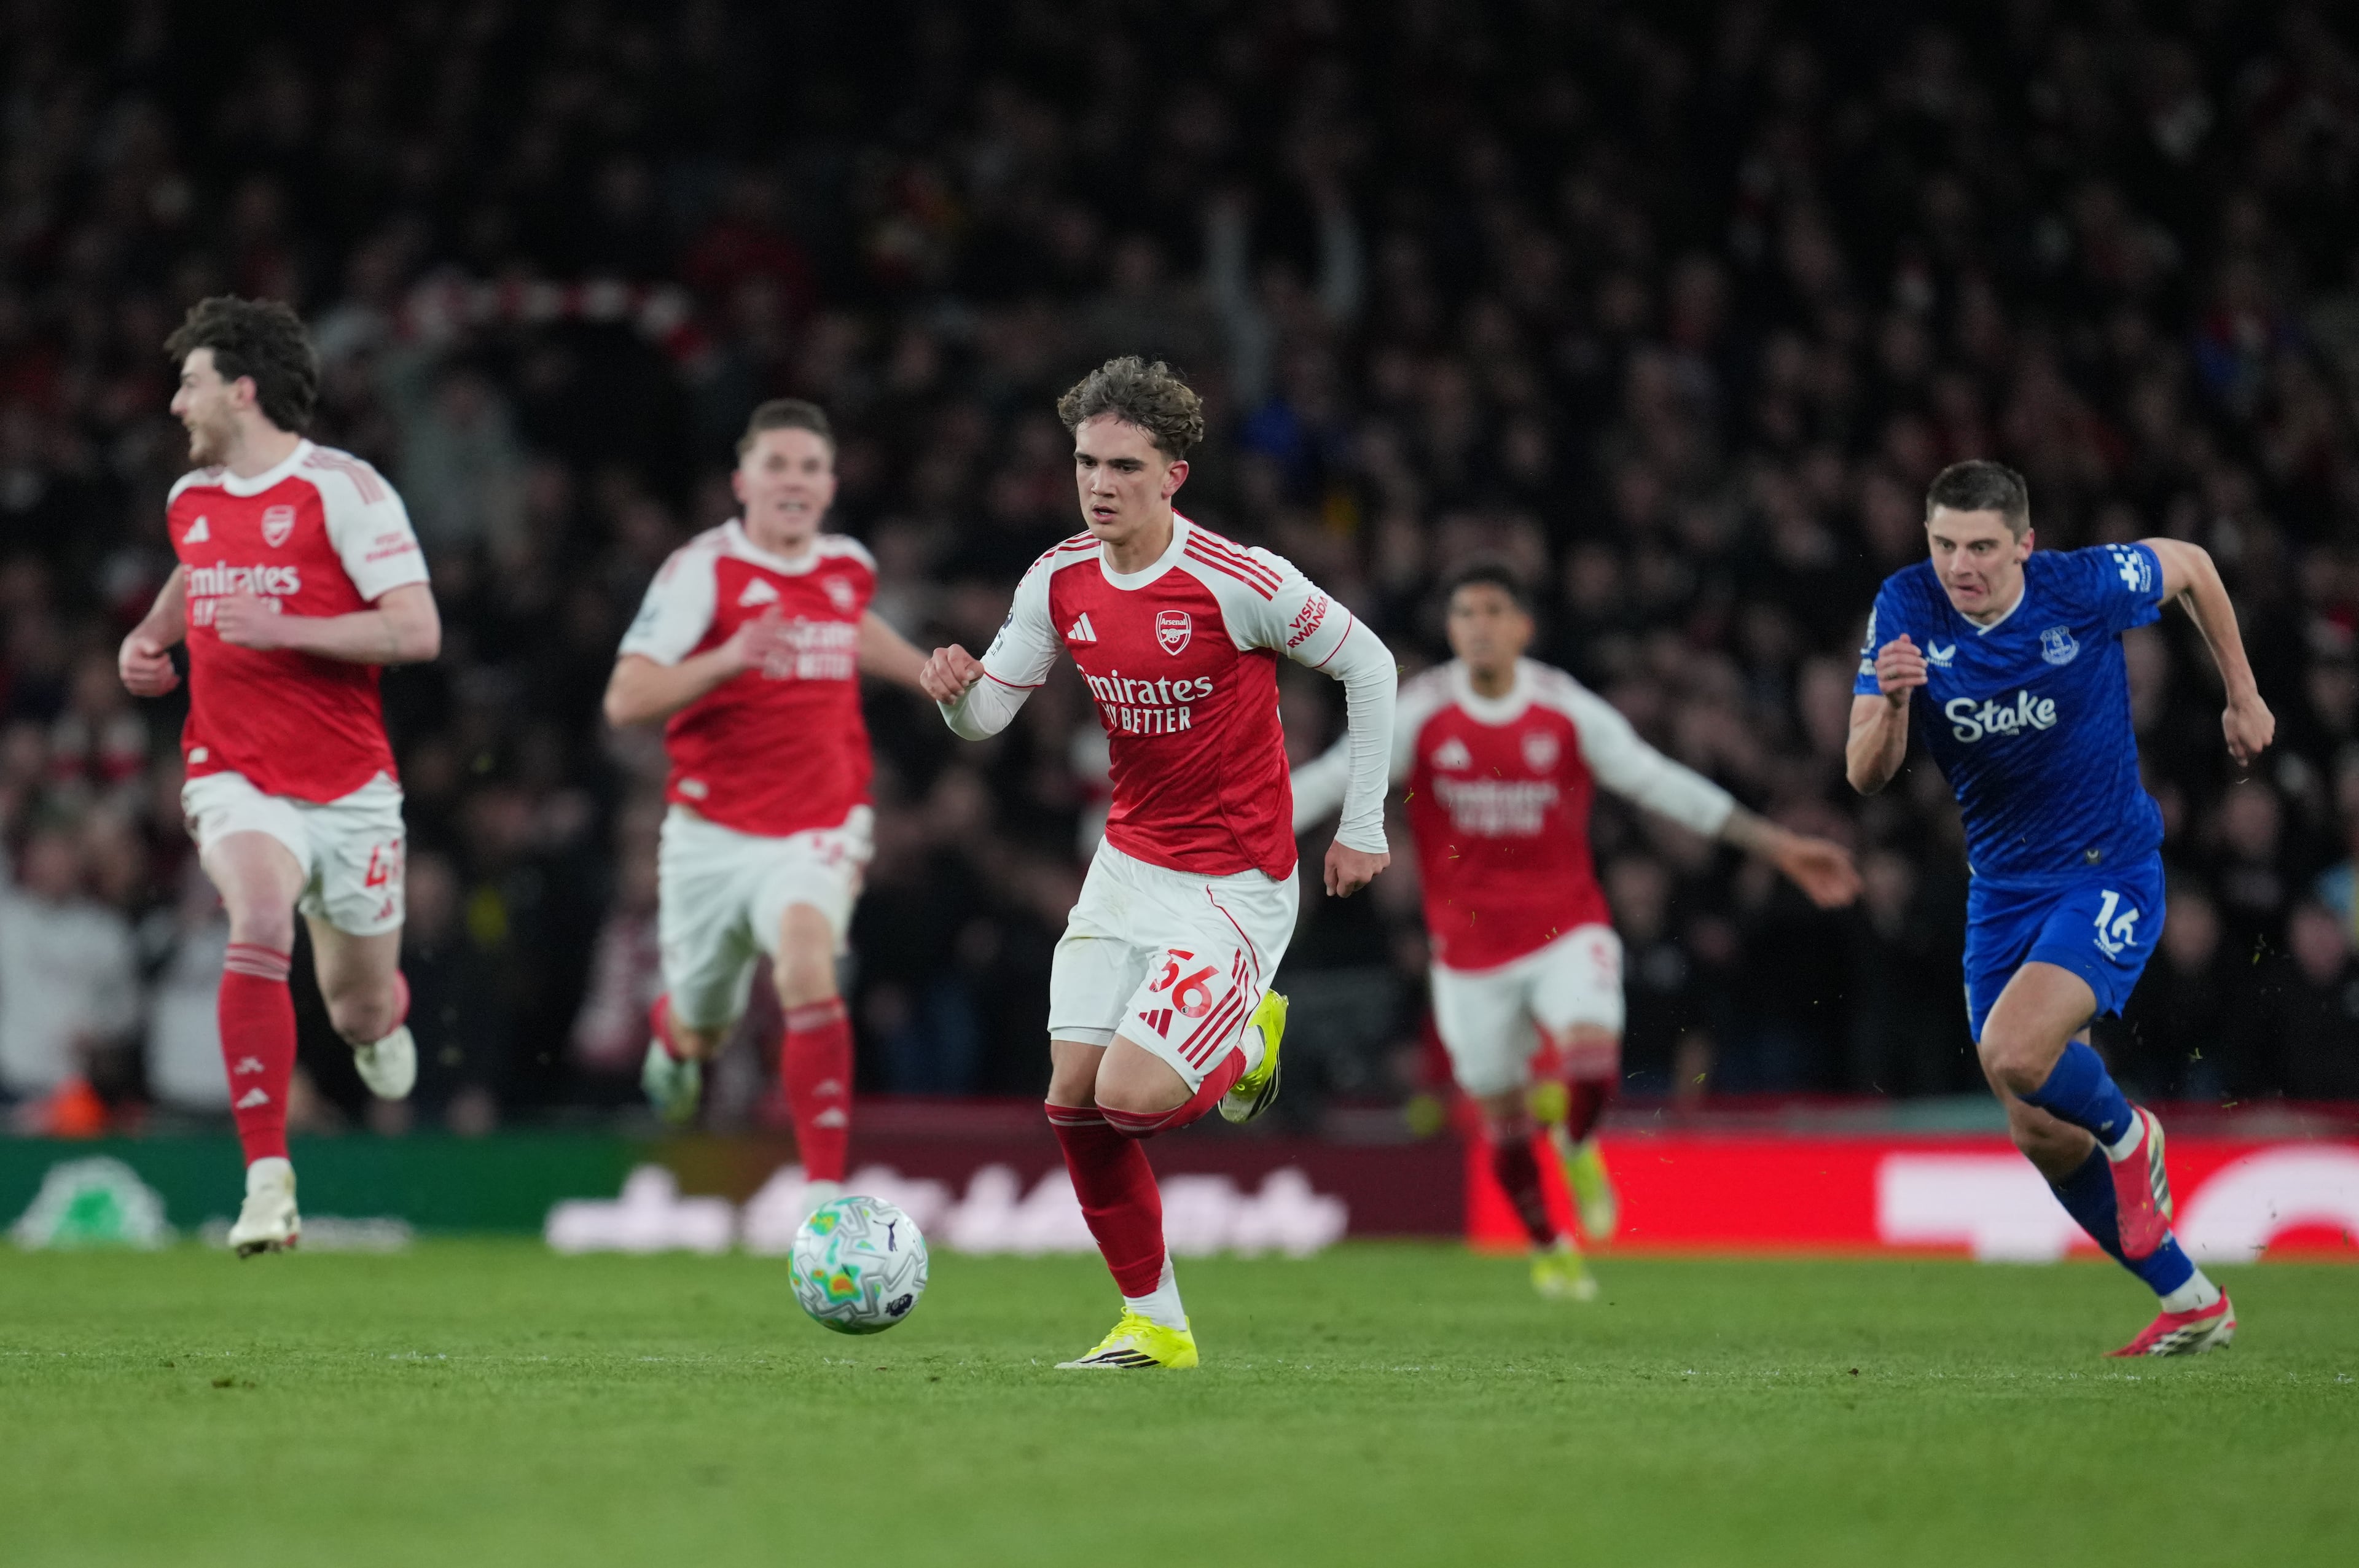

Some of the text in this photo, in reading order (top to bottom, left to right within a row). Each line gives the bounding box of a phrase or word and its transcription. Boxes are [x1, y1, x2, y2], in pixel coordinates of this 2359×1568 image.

[1286, 596, 1328, 649] RWANDA
[1289, 596, 1316, 628] VISIT
[1121, 706, 1192, 734] BETTER
[1946, 690, 2057, 743] Stake
[2094, 889, 2140, 946] 16
[1149, 948, 1219, 1018] 56
